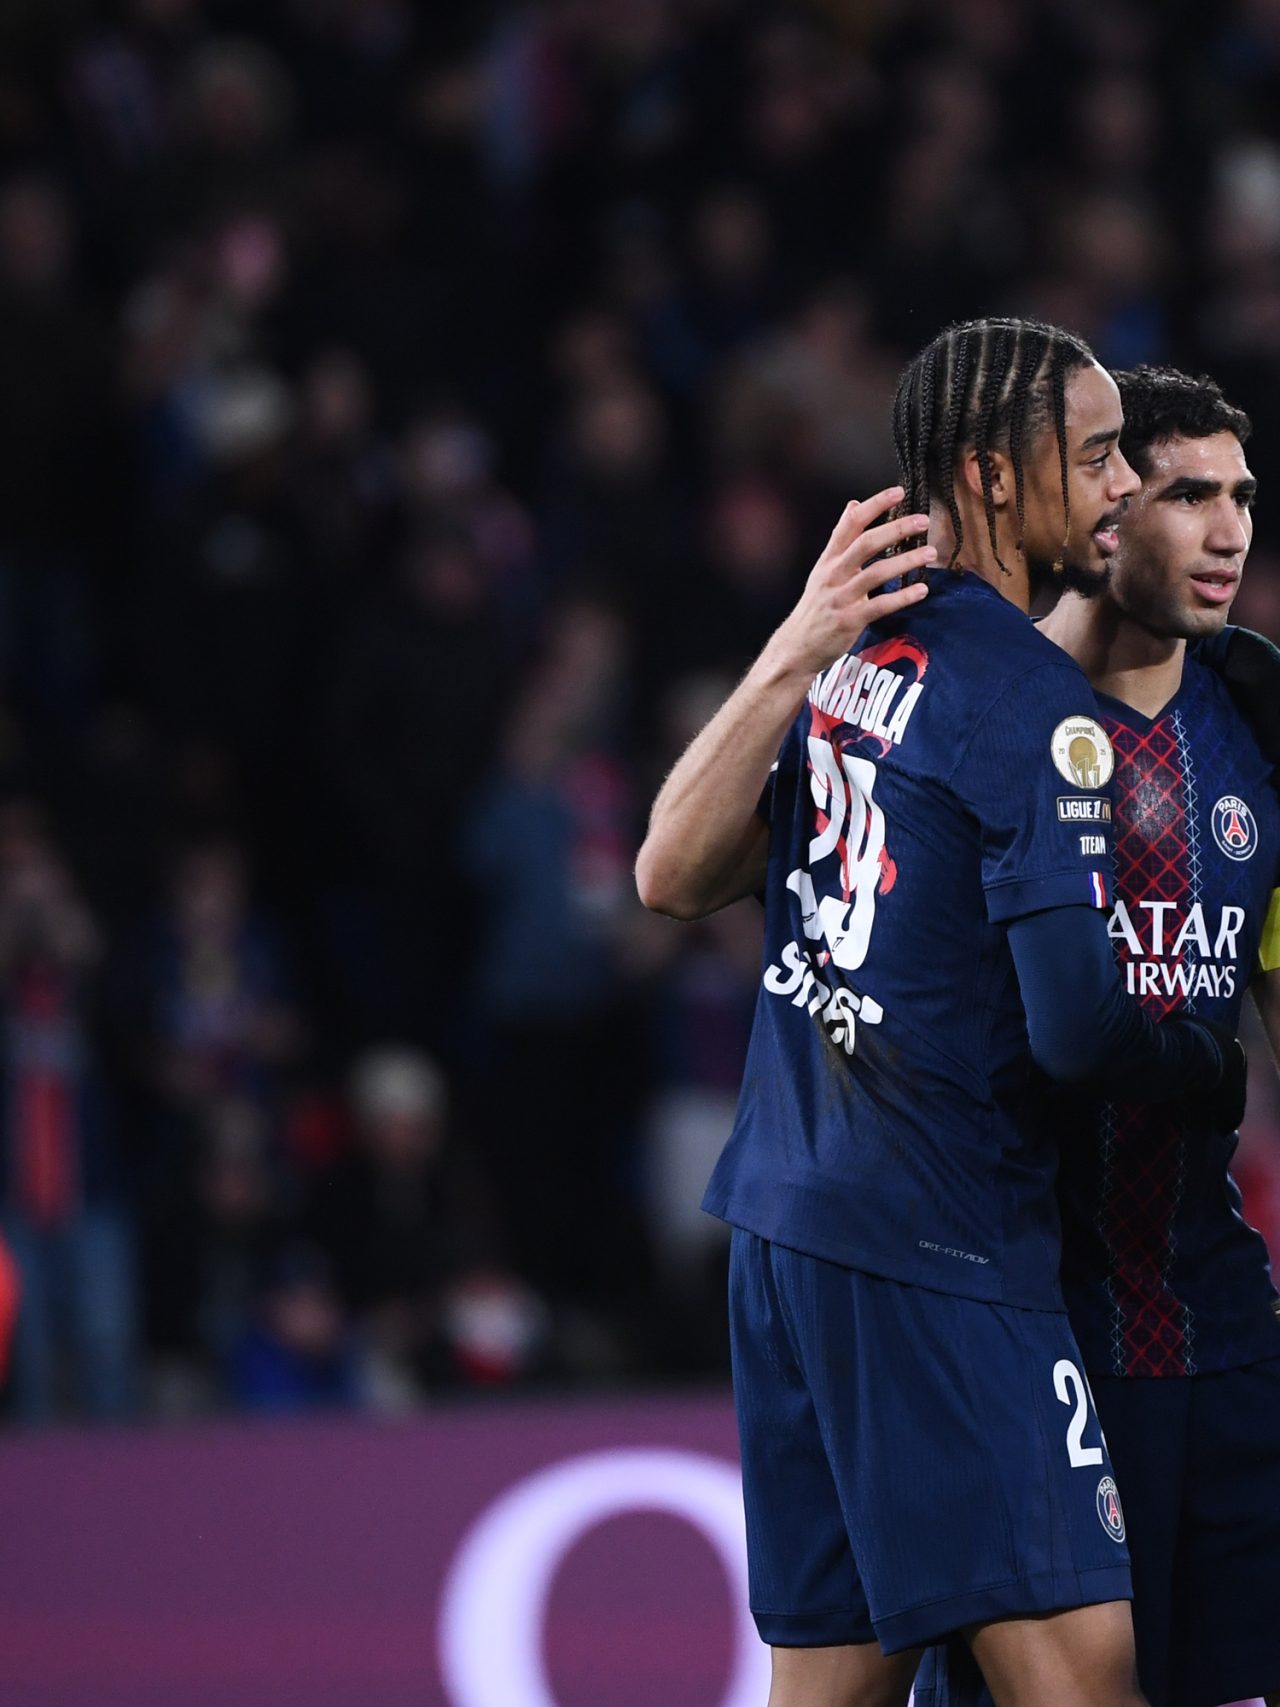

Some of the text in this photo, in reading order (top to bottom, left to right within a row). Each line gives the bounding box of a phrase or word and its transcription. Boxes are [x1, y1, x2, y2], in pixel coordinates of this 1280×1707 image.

[1218, 799, 1249, 817] PARIS
[1107, 899, 1246, 960] ATAR
[1126, 961, 1237, 999] IRWAYS
[1053, 1358, 1107, 1468] 2
